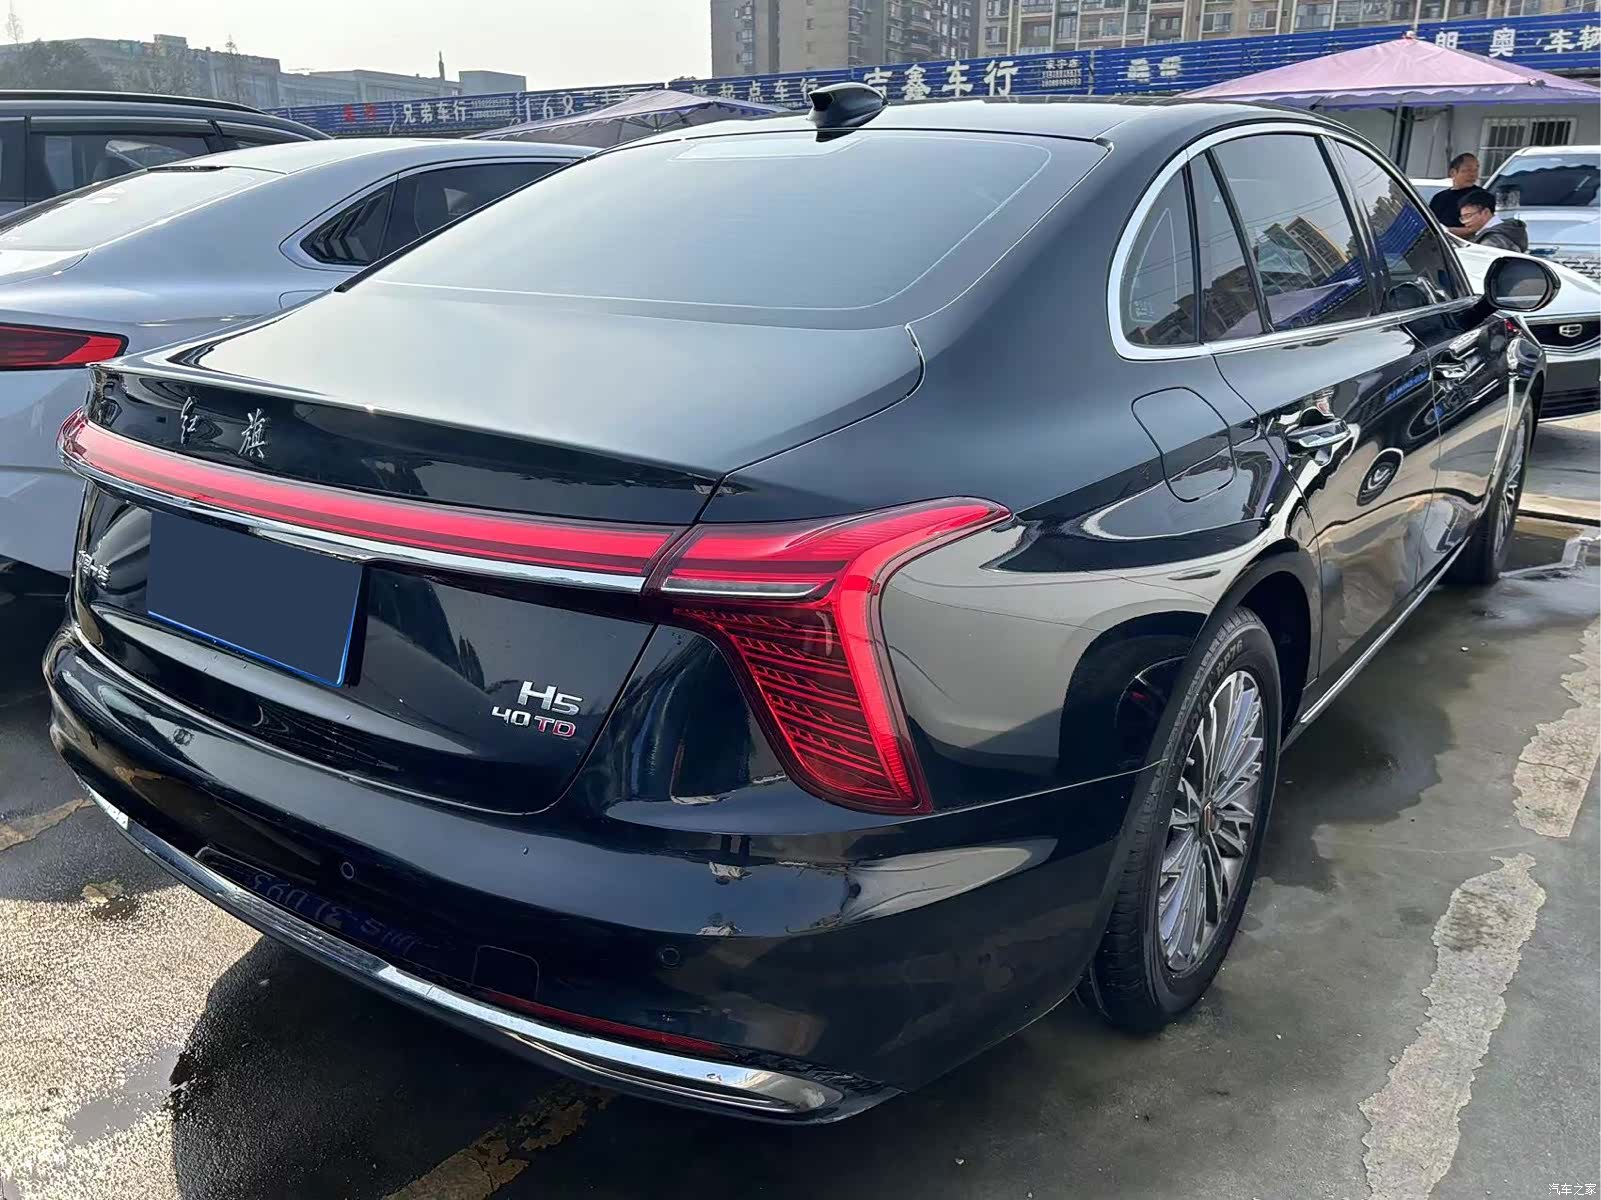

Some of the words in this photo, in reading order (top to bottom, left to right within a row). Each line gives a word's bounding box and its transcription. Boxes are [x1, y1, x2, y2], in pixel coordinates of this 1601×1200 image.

[864, 60, 1019, 100] 吉鑫车行
[403, 100, 467, 124] 兄弟车行
[180, 396, 266, 459] 红旗
[517, 680, 584, 717] H5
